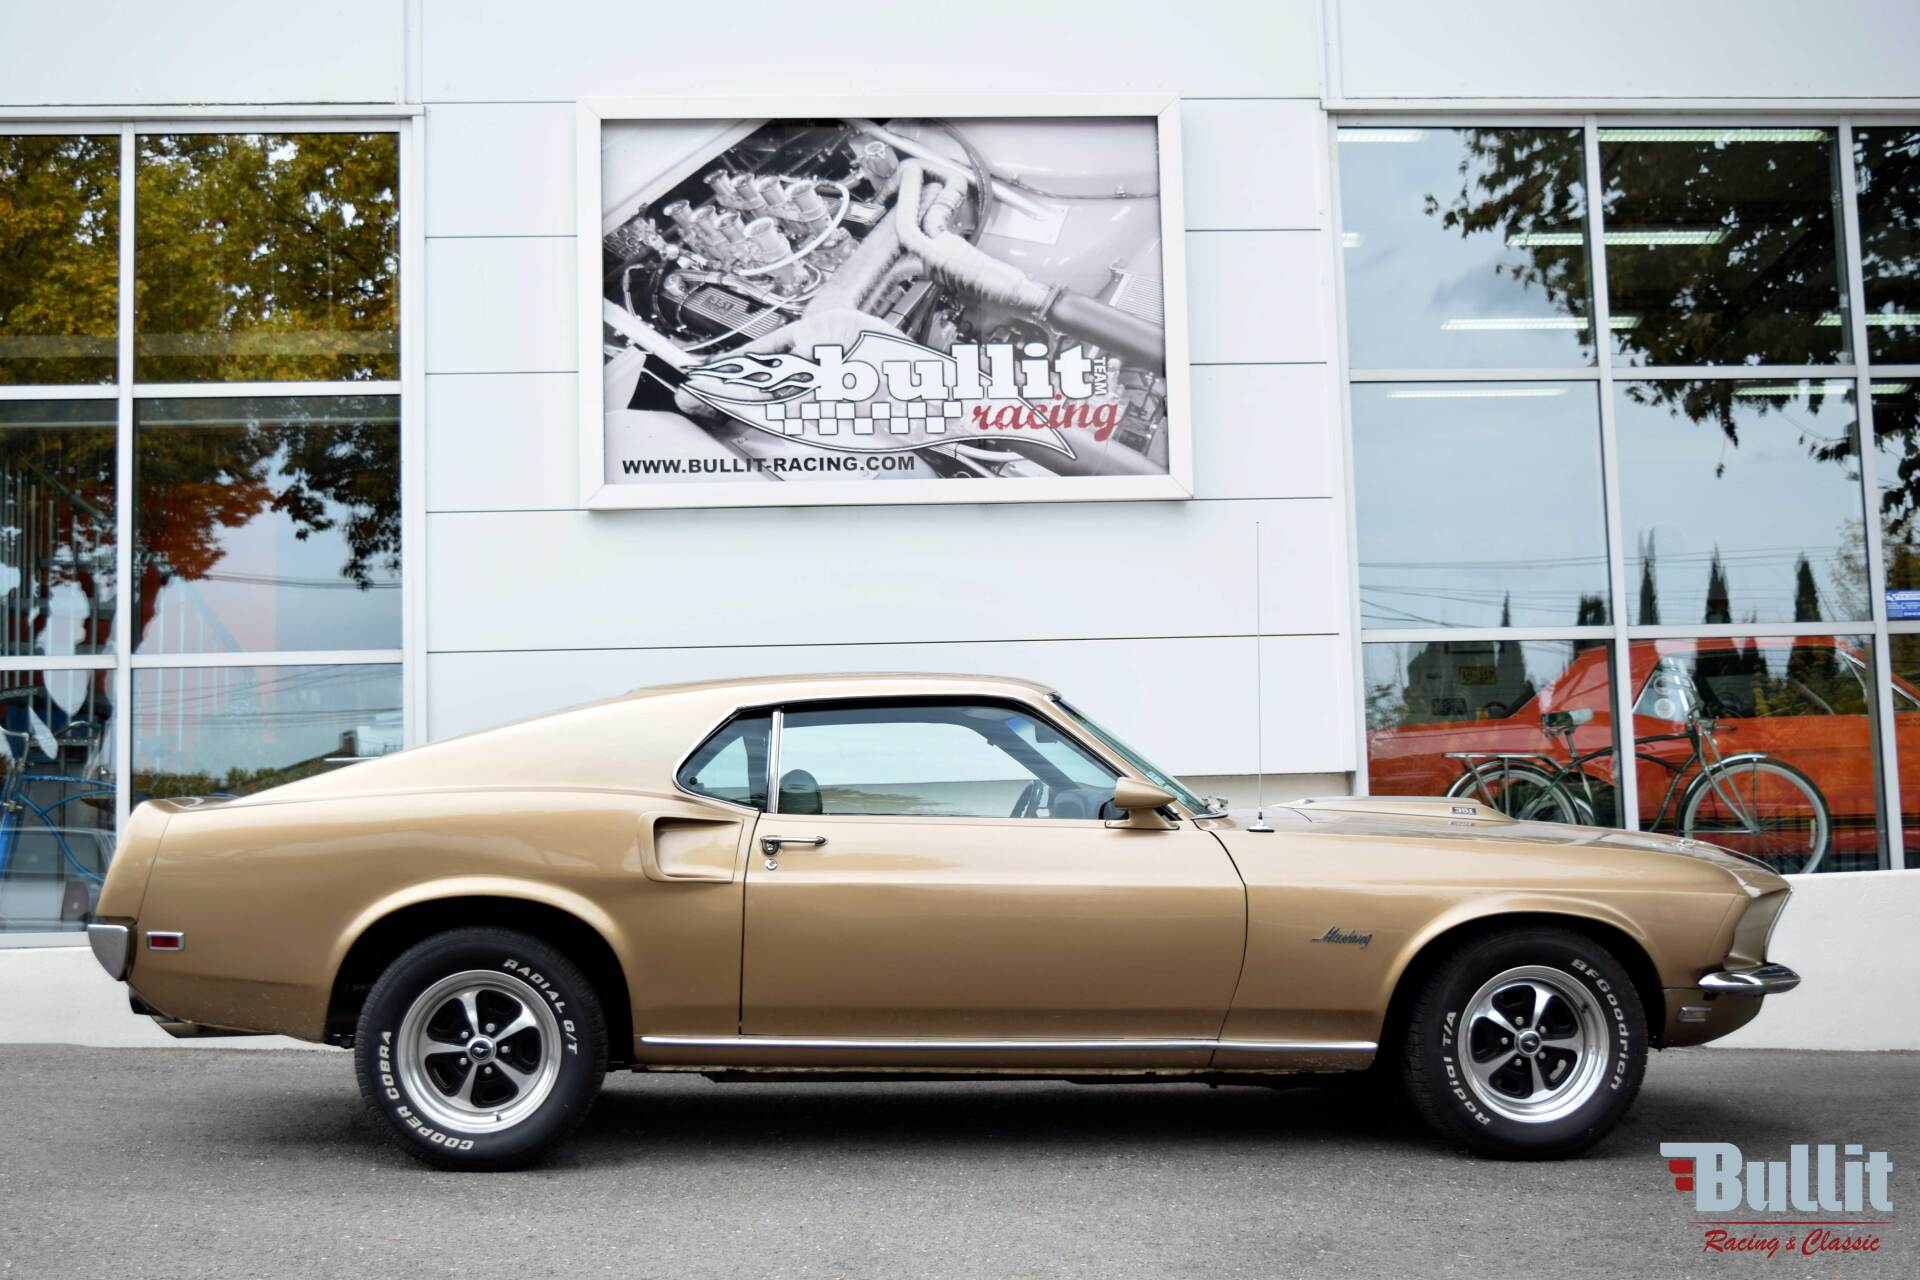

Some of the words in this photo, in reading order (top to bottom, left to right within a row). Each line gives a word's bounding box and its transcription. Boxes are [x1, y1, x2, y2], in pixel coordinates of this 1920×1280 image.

[813, 342, 1094, 401] bullit
[1093, 356, 1108, 396] TEAM
[971, 393, 1124, 442] racing
[622, 456, 915, 474] WWW.BULLIT-RACING.COM
[503, 958, 566, 1014] RADIAL
[1442, 1012, 1457, 1047] T/A
[1571, 958, 1630, 1090] BFGoodrich
[379, 1032, 400, 1100] COBRA
[1443, 1057, 1492, 1126] Radial
[397, 1106, 474, 1150] COOPER
